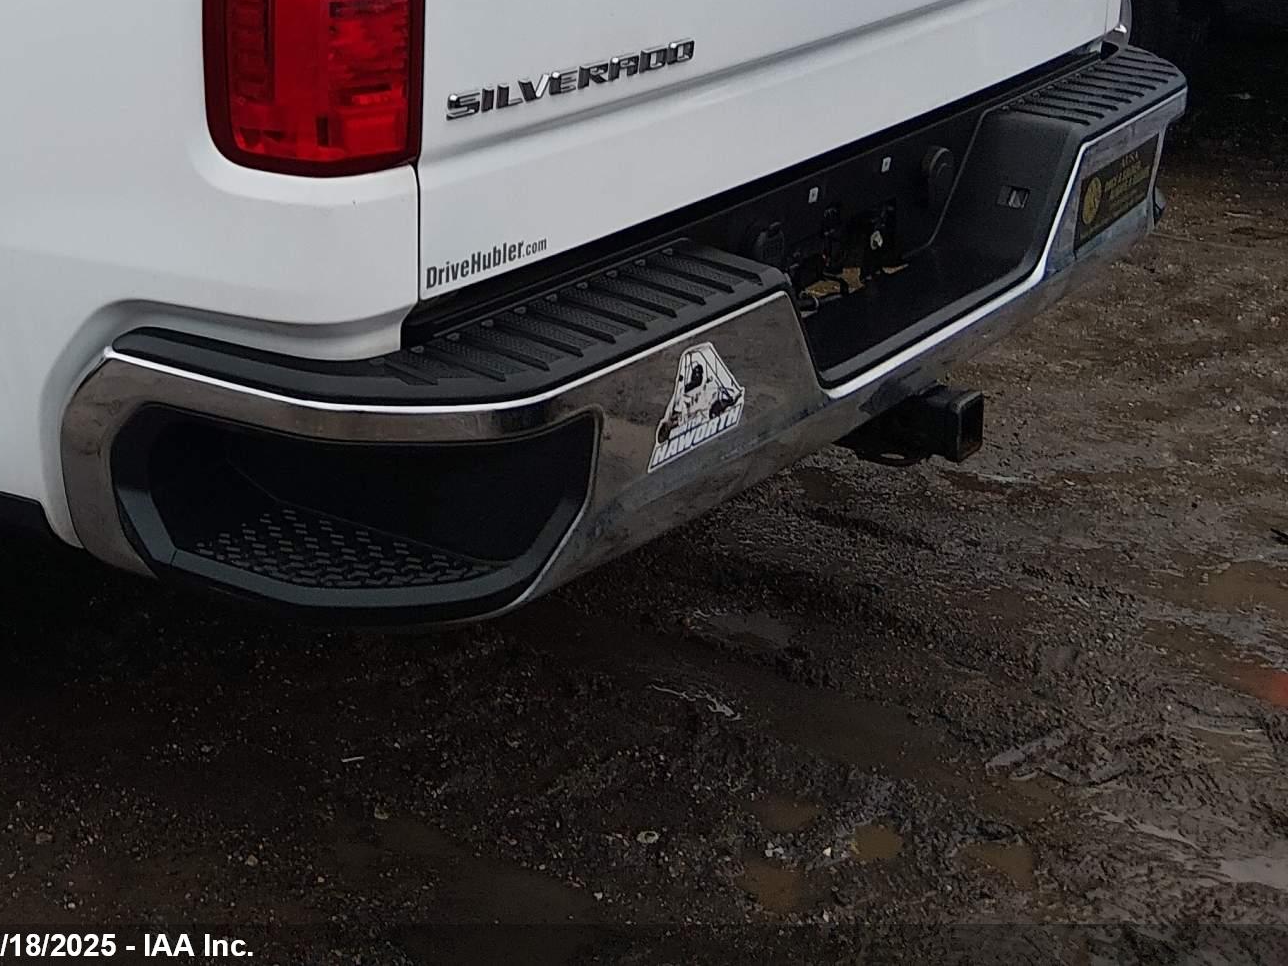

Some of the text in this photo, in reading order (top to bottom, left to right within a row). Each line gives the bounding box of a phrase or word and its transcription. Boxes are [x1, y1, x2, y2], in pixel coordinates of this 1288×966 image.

[446, 37, 695, 121] SILVERADO
[426, 238, 547, 289] DriveHubler.com
[651, 402, 742, 468] HAWORTH
